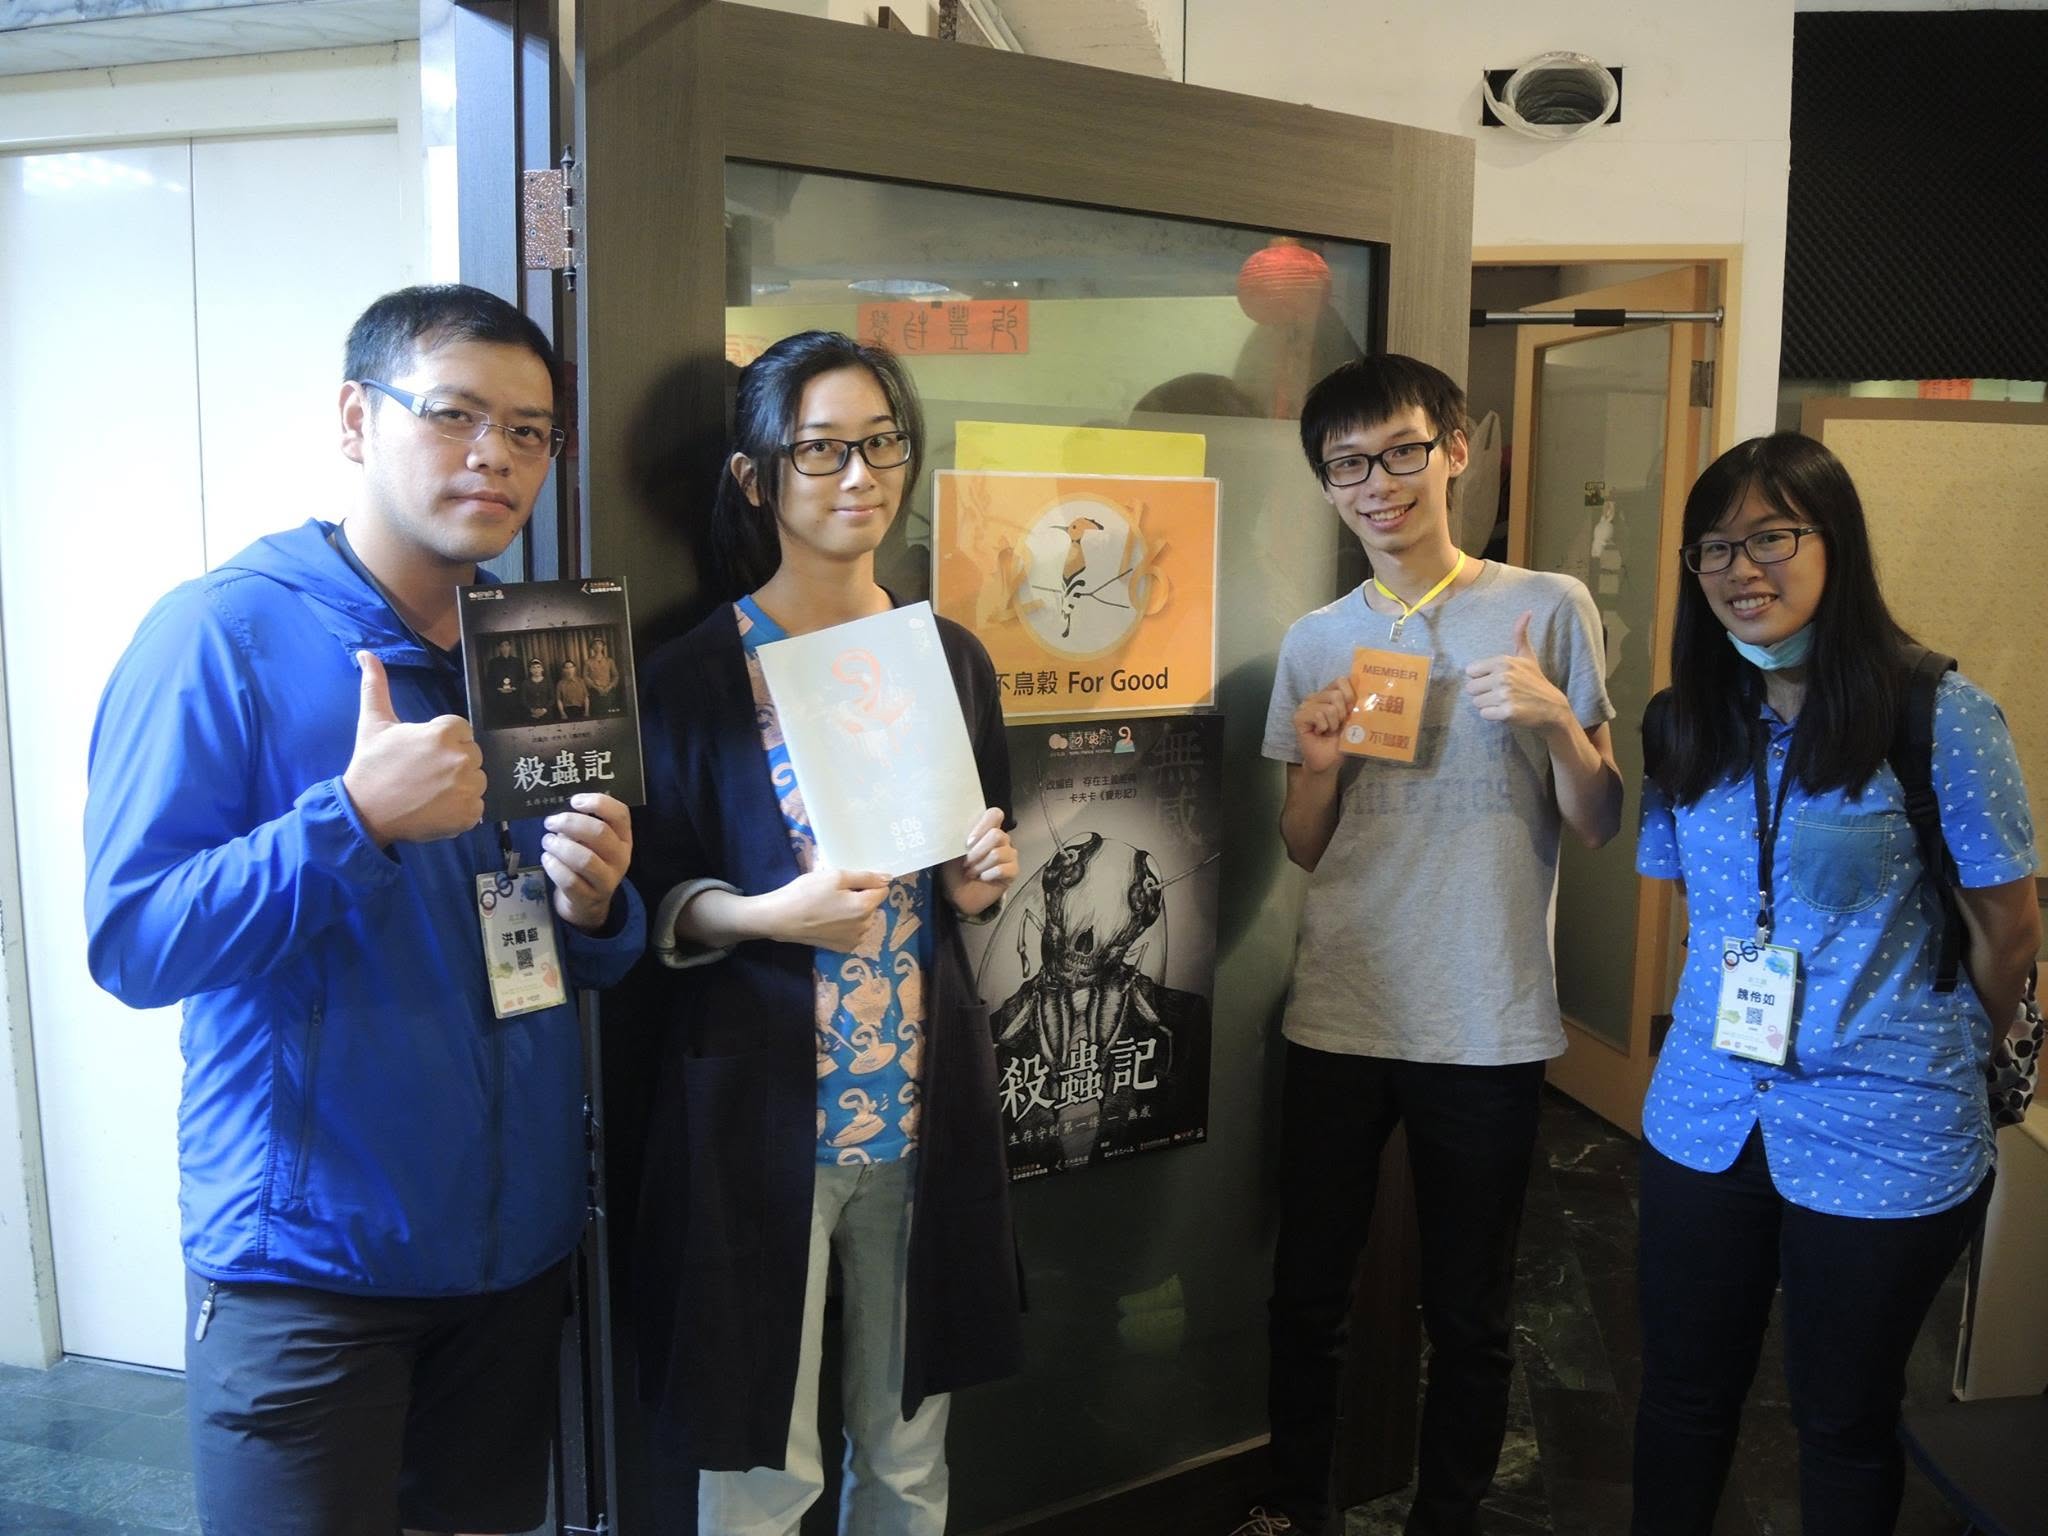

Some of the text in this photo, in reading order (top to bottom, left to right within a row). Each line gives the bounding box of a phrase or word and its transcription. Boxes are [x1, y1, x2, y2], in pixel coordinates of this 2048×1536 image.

[1068, 671, 1104, 694] For
[1110, 667, 1168, 692] Good
[1362, 664, 1418, 681] MEMBER
[513, 750, 615, 792] 殺蟲記
[1000, 1037, 1158, 1123] 殺蟲記
